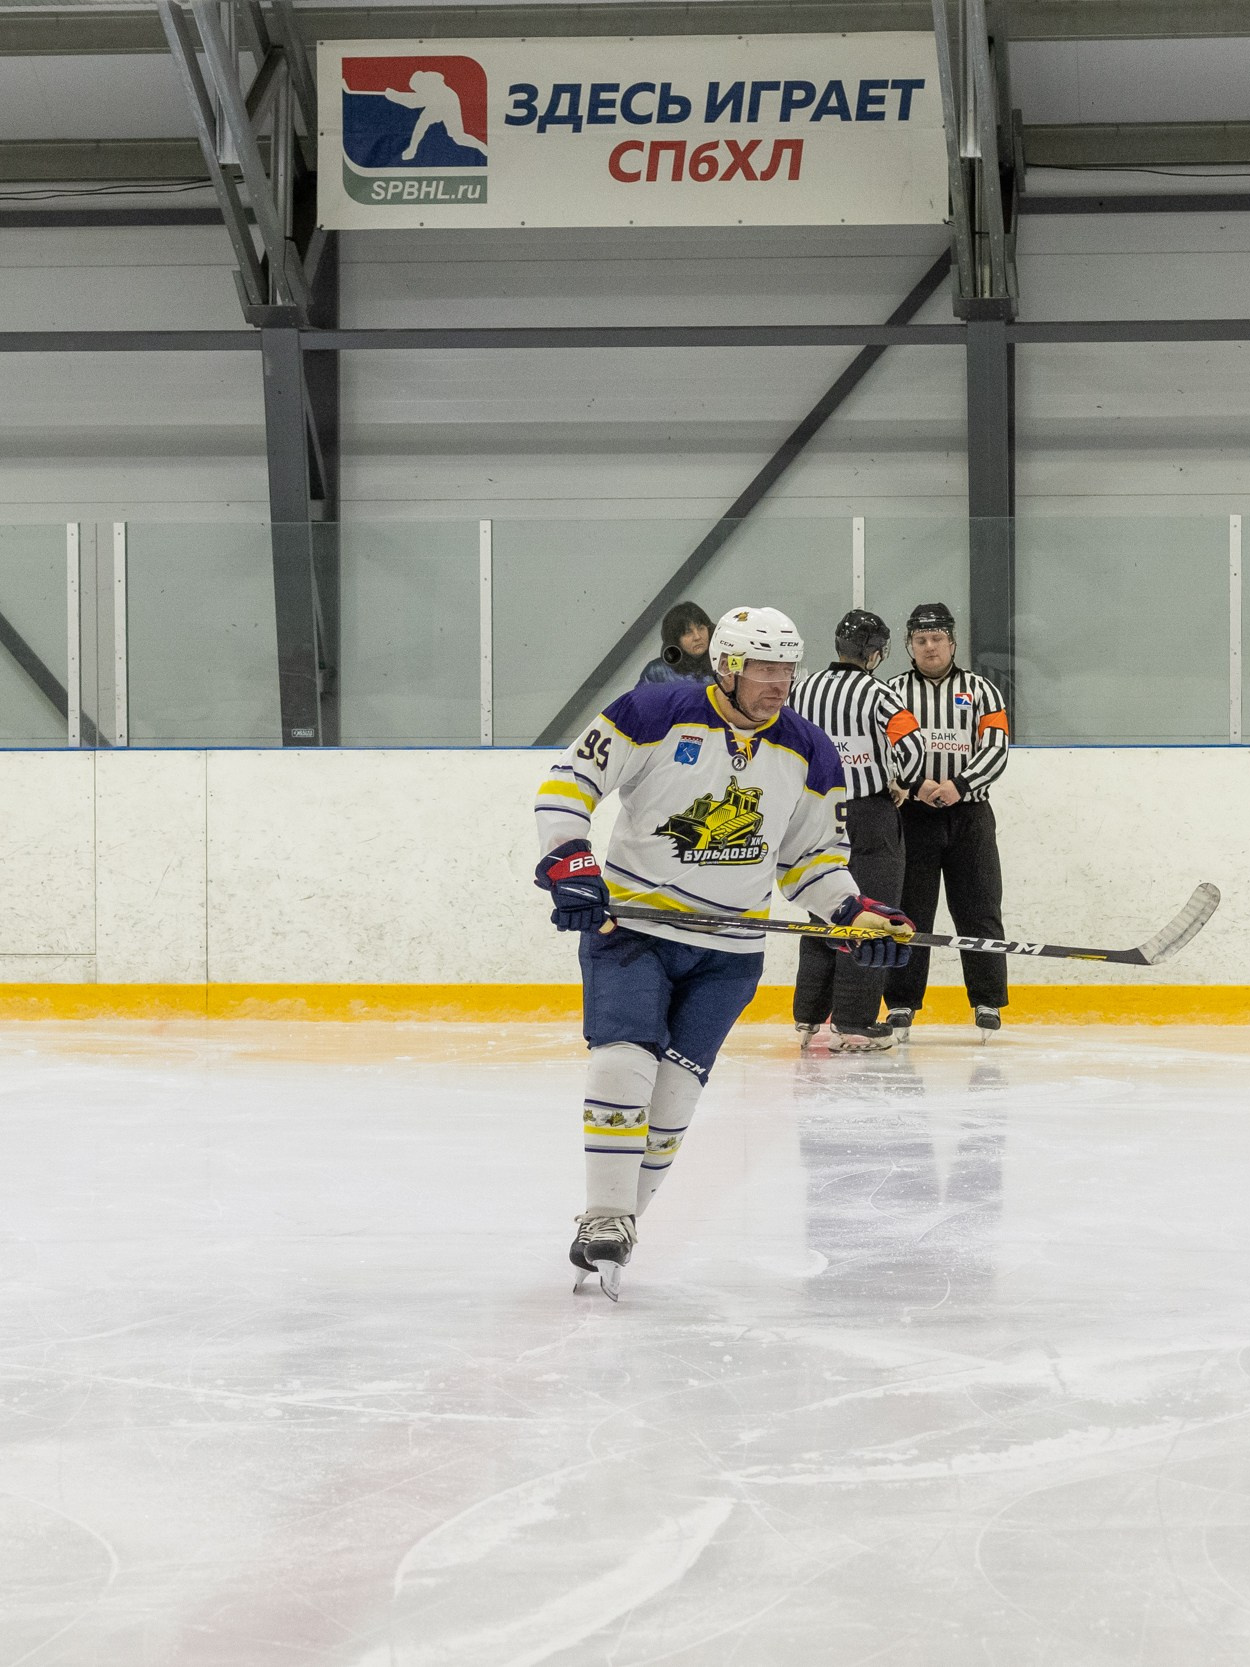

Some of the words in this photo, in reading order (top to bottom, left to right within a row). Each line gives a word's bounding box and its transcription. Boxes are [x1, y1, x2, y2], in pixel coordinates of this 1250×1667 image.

[504, 82, 692, 133] ЗДЕСЬ
[704, 78, 925, 124] ИГРАЕТ
[608, 138, 804, 183] СПбХЛ
[371, 181, 481, 200] SPBHL.ru
[719, 640, 735, 648] CCM
[930, 731, 957, 741] БАНК
[833, 741, 850, 753] НК
[930, 741, 970, 753] РОССИЯ
[841, 752, 872, 765] СИЯ
[683, 846, 760, 862] БУЛЬДОЗЕР
[787, 924, 827, 933] SUPER
[948, 935, 1046, 955] CCM
[665, 1047, 706, 1075] CCM
